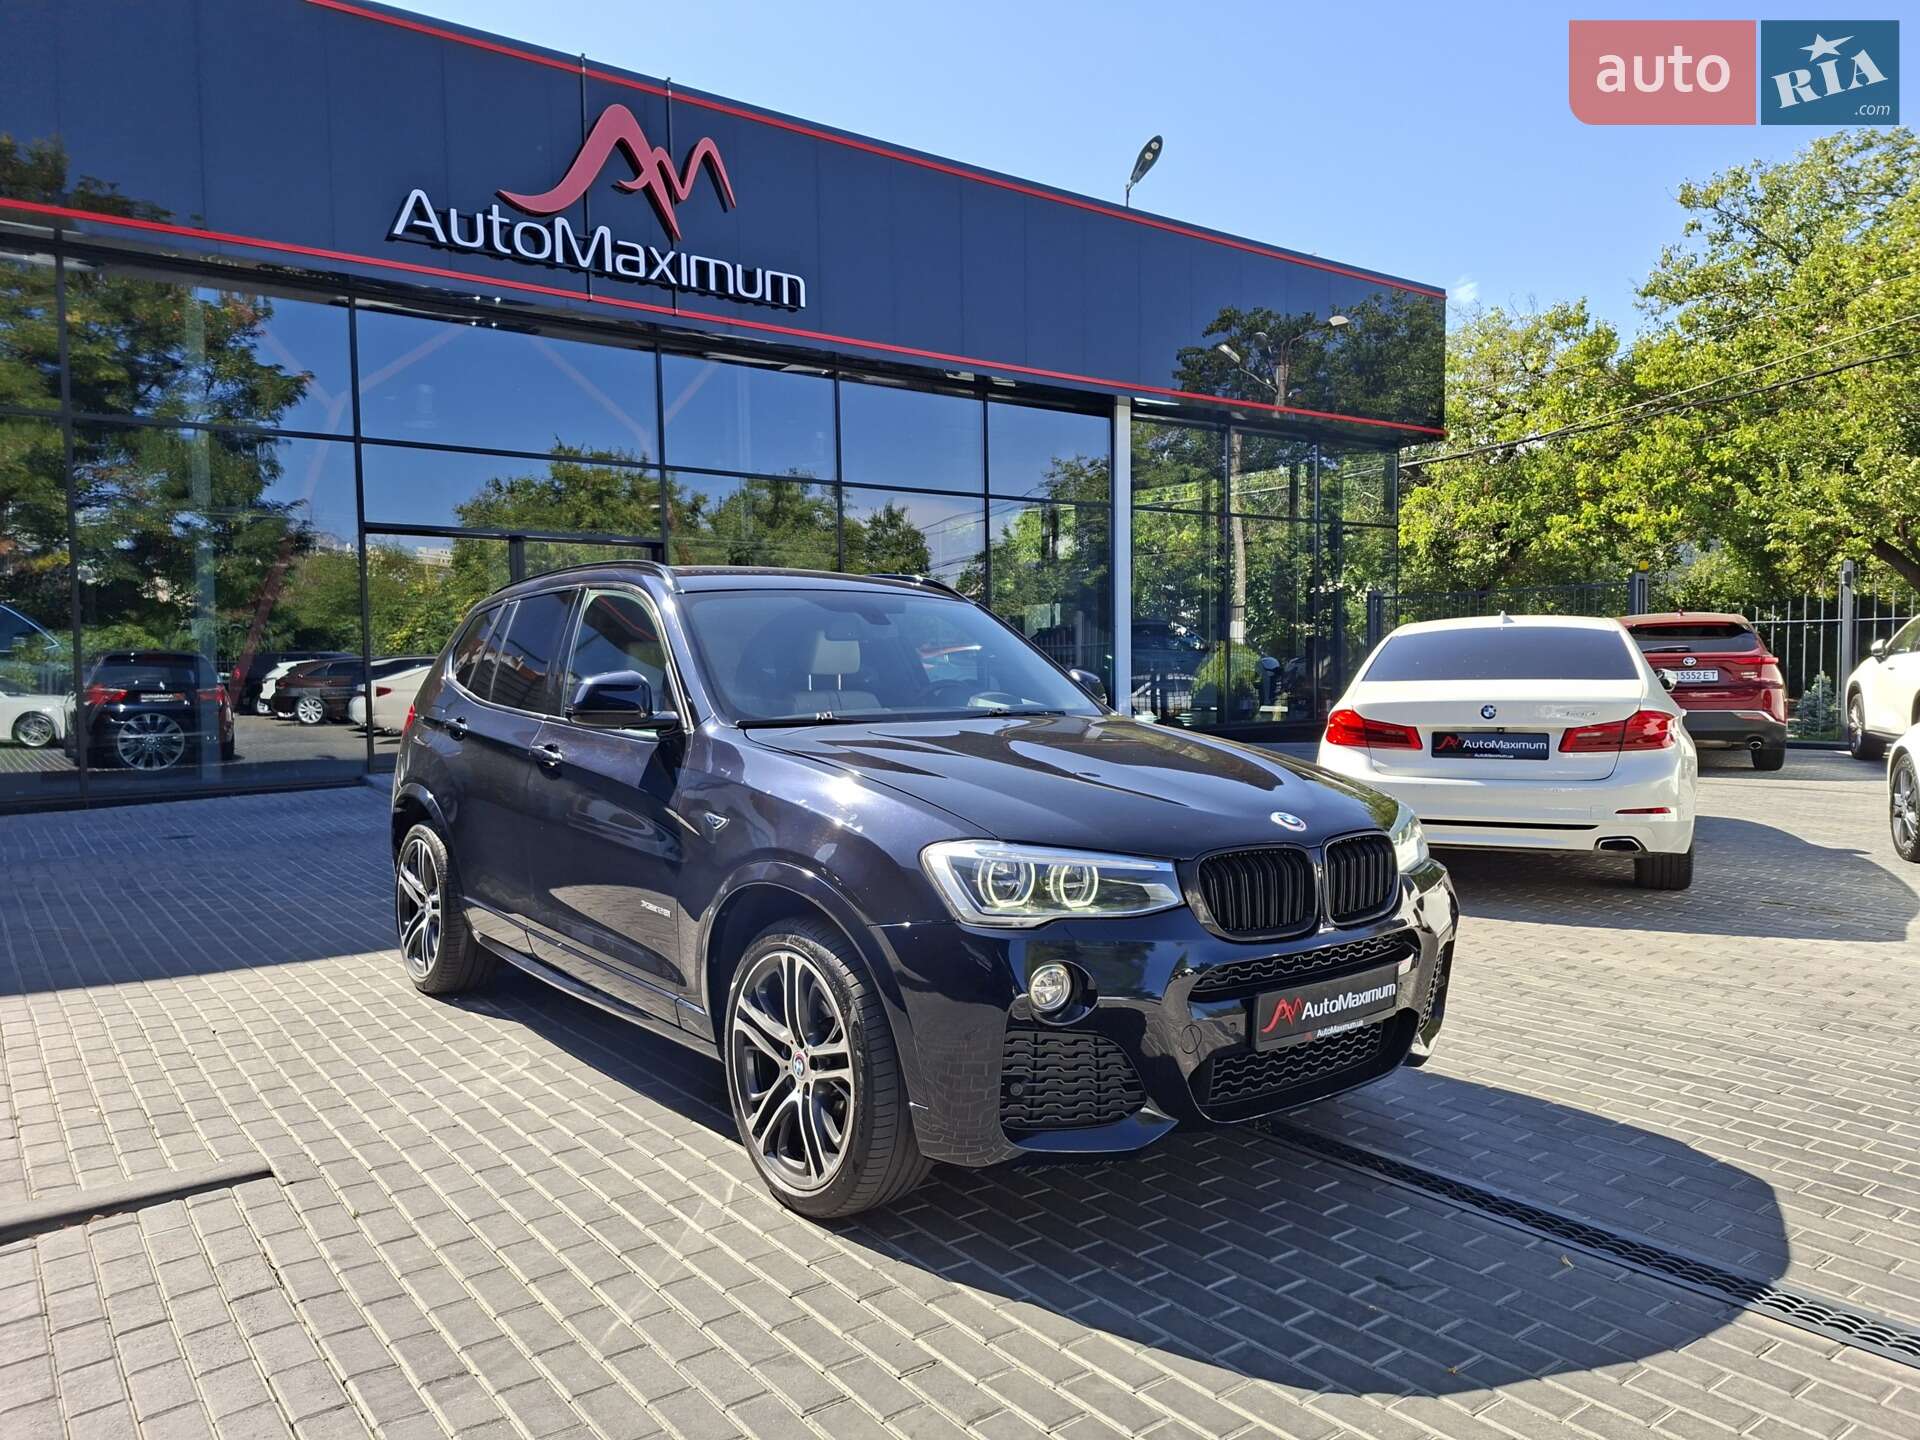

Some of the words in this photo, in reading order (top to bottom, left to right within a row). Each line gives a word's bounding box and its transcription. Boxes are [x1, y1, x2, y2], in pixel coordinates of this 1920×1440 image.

[388, 188, 807, 308] AutoMaximum
[1462, 739, 1548, 751] AutoMaximum
[1301, 983, 1396, 1021] AutoMaximum
